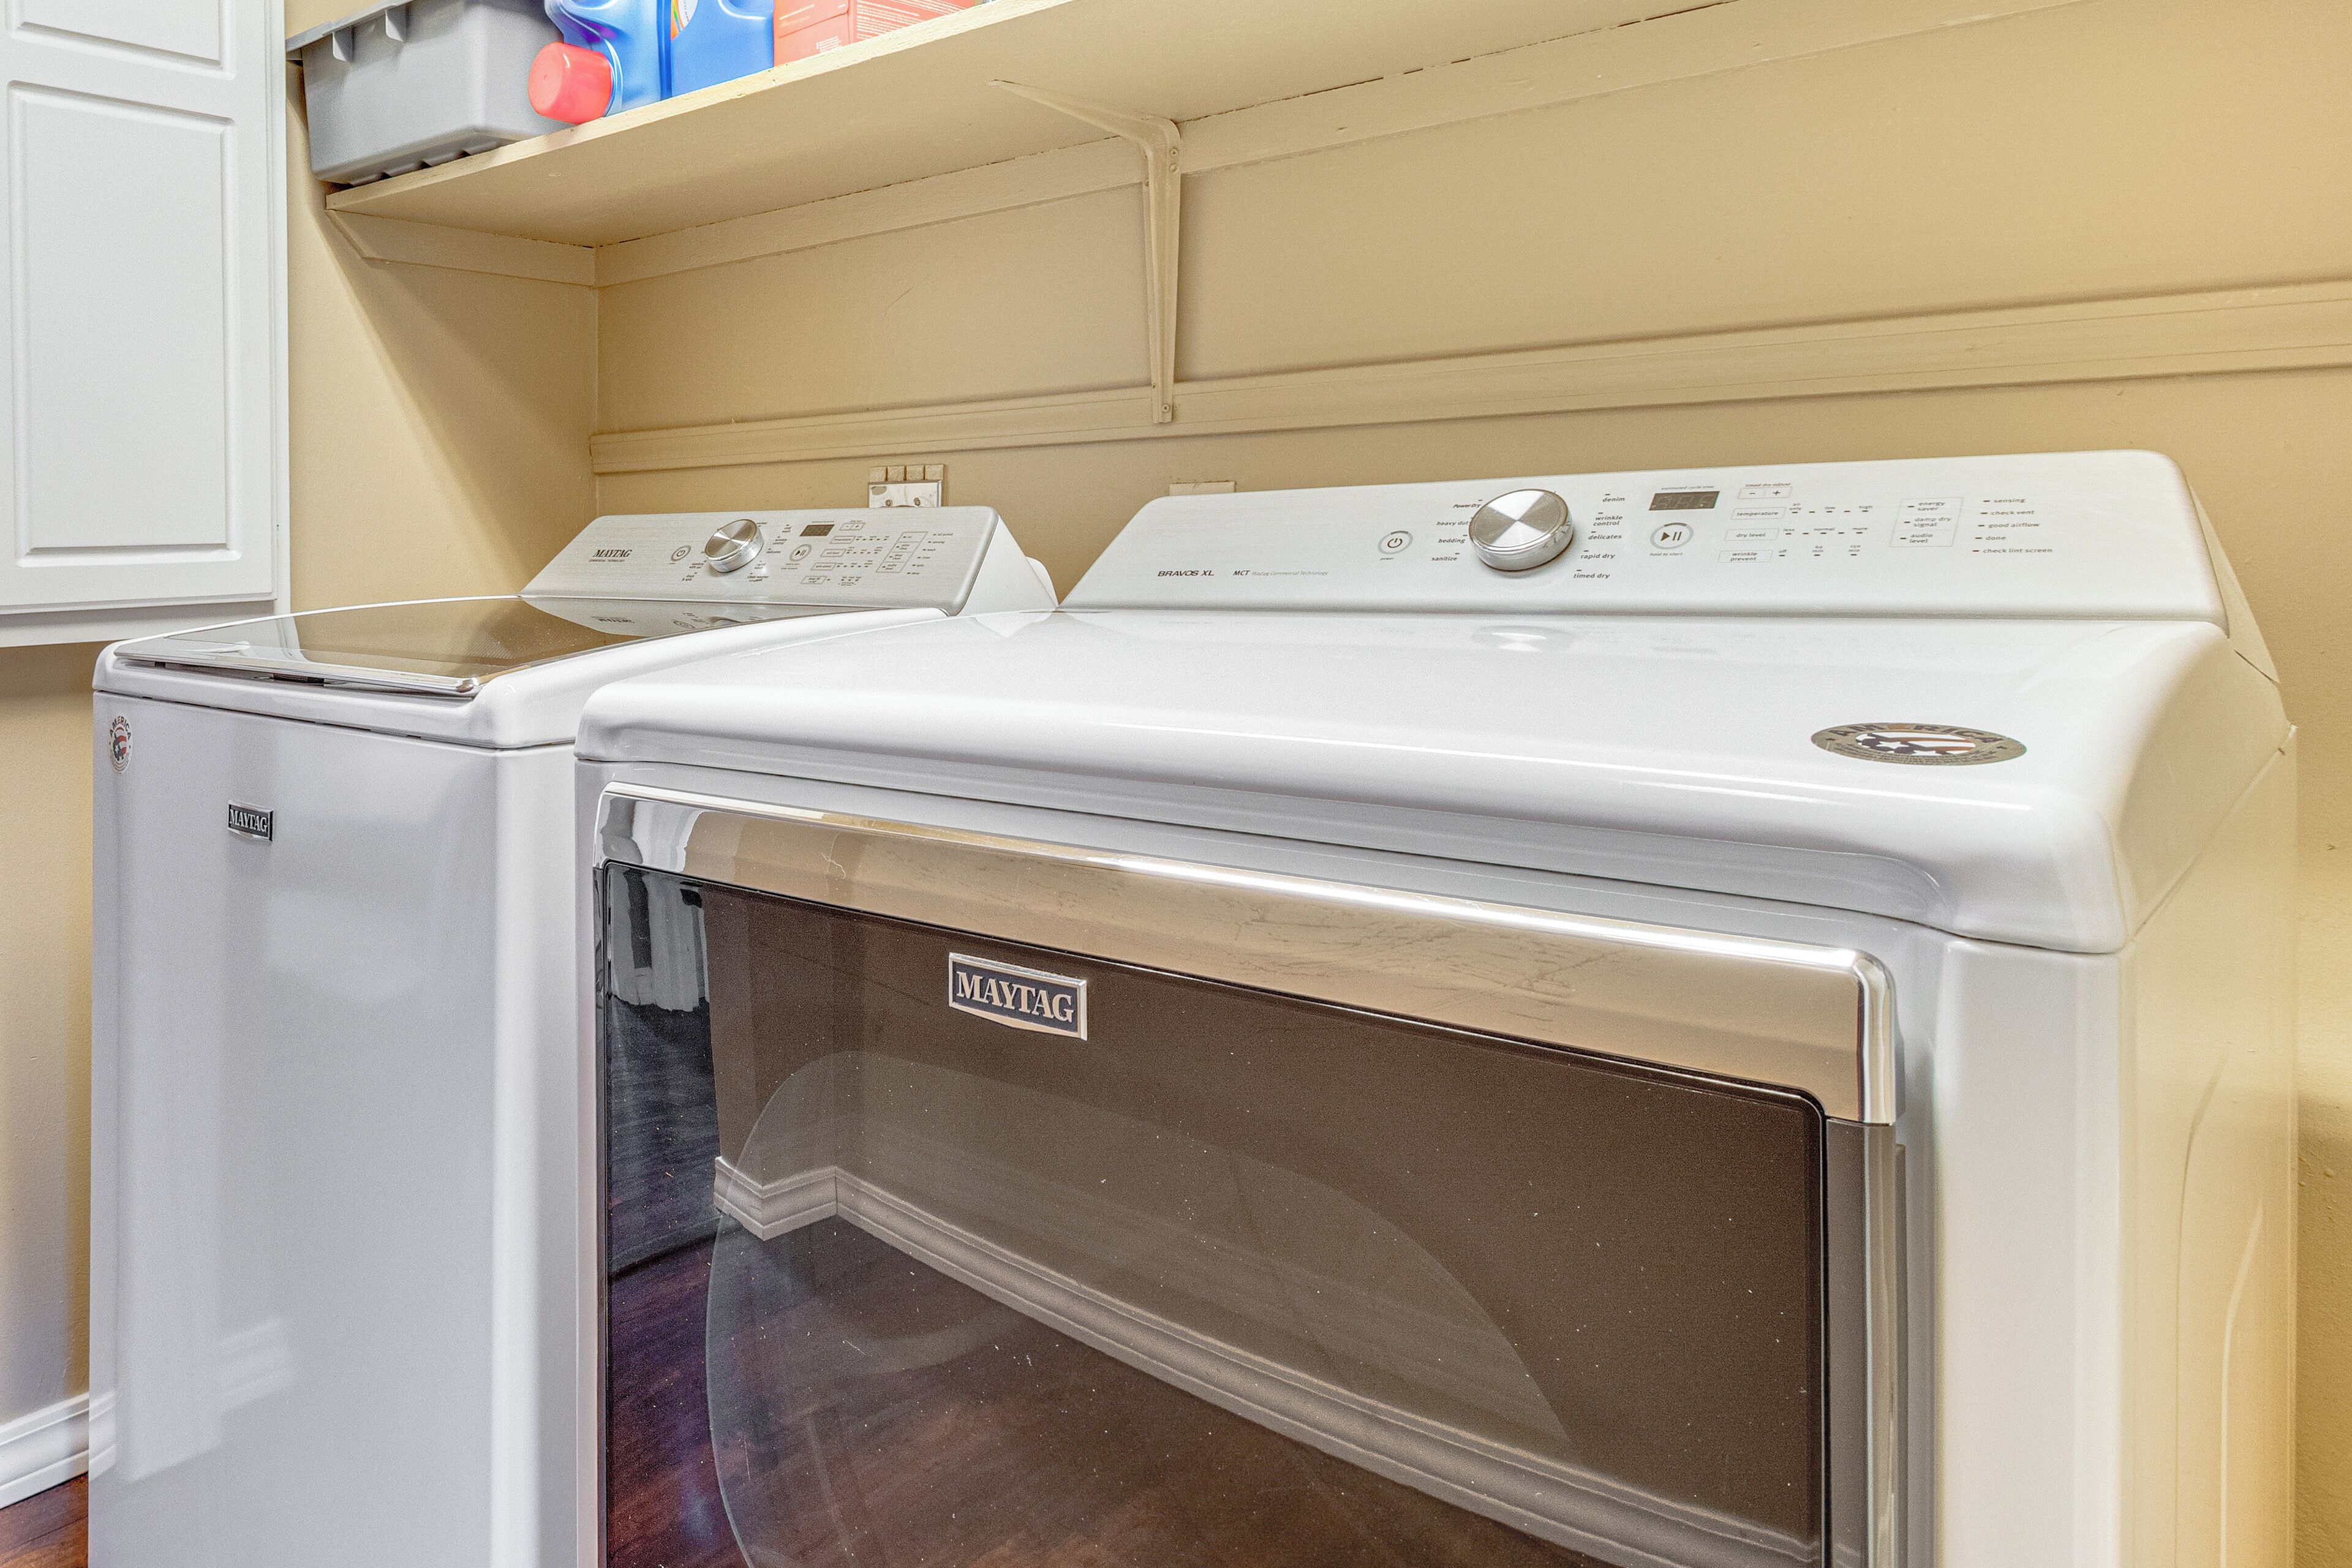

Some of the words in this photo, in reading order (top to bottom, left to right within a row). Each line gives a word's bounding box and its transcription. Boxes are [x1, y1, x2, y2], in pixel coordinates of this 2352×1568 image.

[109, 715, 131, 741] AMERICA
[1828, 723, 2005, 744] AMERICA
[229, 809, 268, 833] MAYTAG
[956, 971, 1074, 1023] MAYTAG
